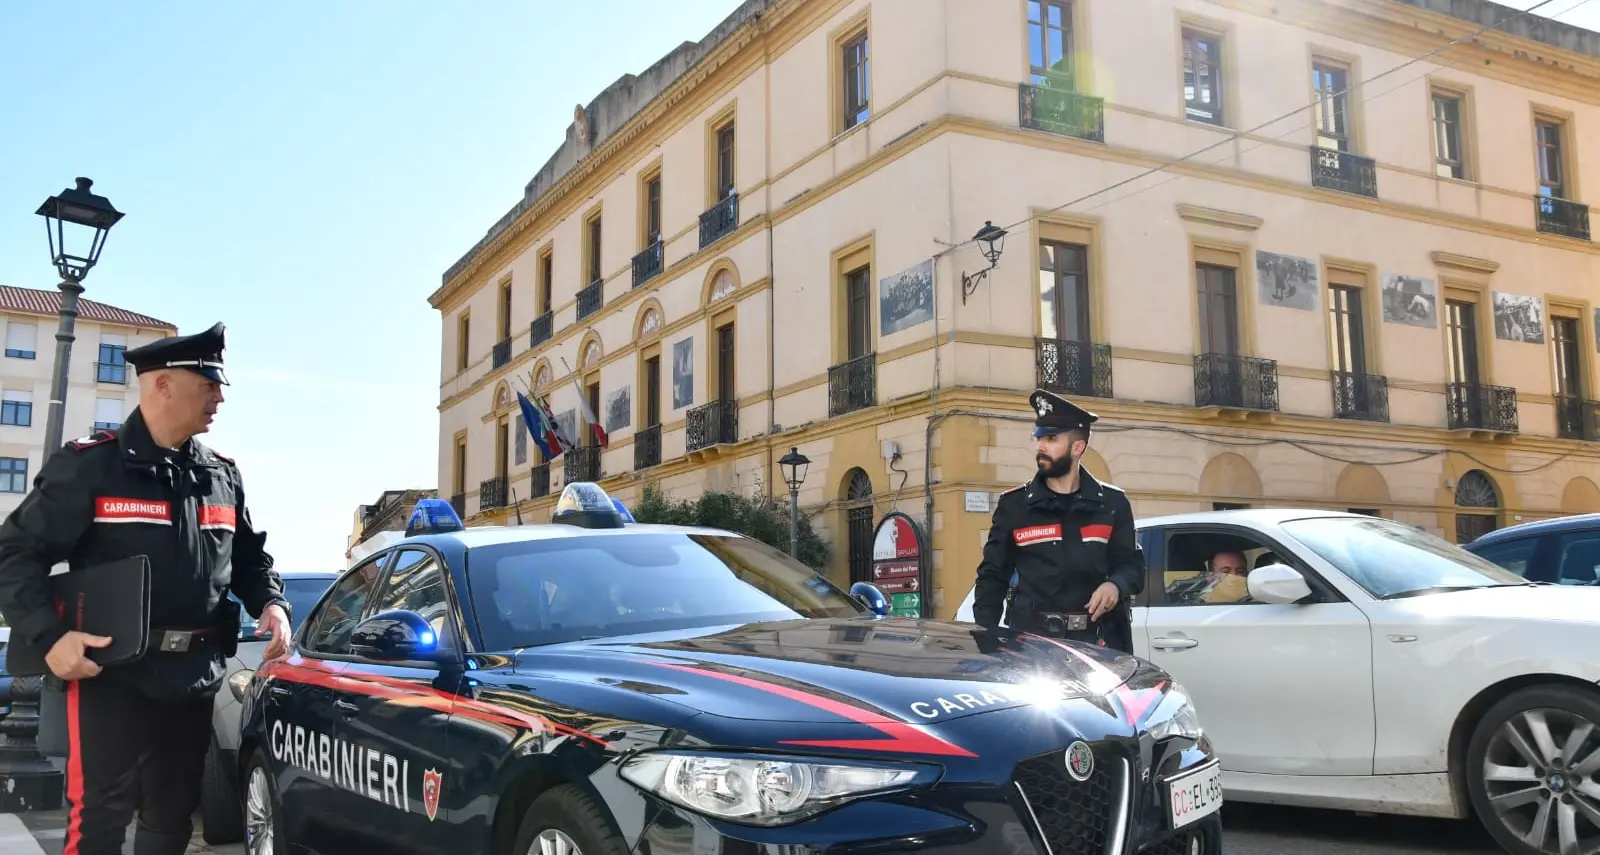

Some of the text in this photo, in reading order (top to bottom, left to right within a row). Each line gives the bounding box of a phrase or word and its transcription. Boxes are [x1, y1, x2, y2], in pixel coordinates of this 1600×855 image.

[103, 502, 167, 515] CARABINIERI
[1016, 527, 1056, 540] CARABINIERI
[271, 719, 410, 813] CARABINIERI
[1173, 790, 1188, 817] CC
[1193, 782, 1206, 810] EL
